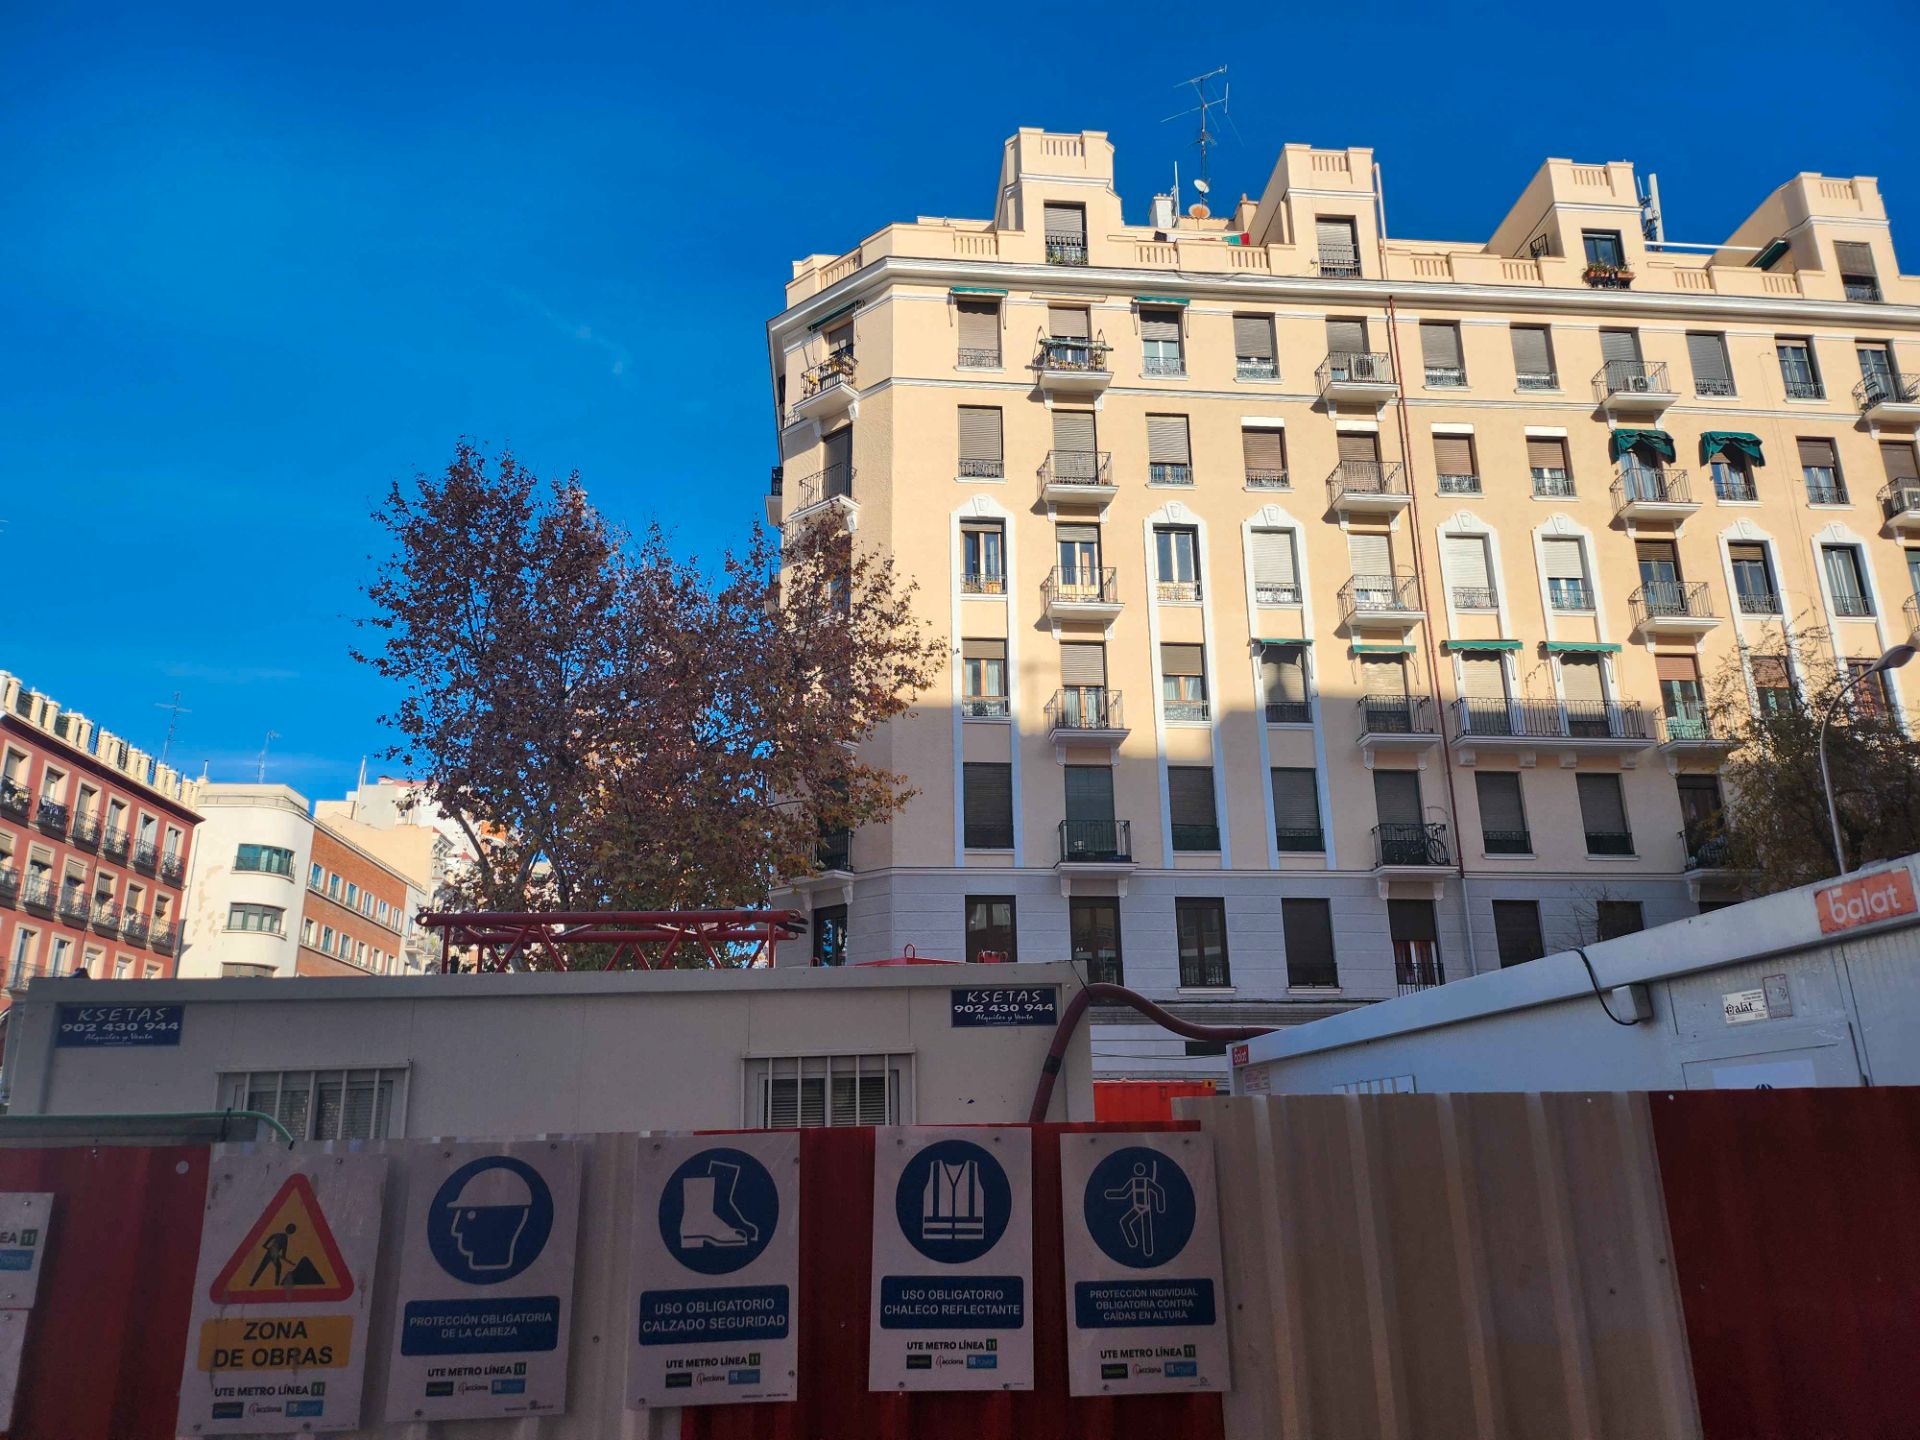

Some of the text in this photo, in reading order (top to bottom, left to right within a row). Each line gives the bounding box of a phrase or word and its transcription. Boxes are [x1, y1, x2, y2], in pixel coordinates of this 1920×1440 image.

[1828, 884, 1901, 924] balat
[967, 990, 1041, 1003] KSETAS
[954, 1003, 1054, 1013] 902 430 944
[78, 1008, 170, 1022] KSETAS
[61, 1022, 179, 1032] 902 430 944
[902, 1289, 1004, 1301] USO OBLIGATORIO
[1090, 1287, 1198, 1299] PROTECCIÓN INDIVIDUAL
[655, 1298, 775, 1315] USO OBLIGATORIO
[884, 1304, 1021, 1315] CHALECO REFLECTANTE
[1096, 1298, 1194, 1310] OBLIGATORIA CONTRA
[409, 1312, 552, 1327] PROTECCIÓN OBLIGATORIA
[1103, 1310, 1188, 1321] CAÍDAS EN ALTURA
[642, 1314, 786, 1332] CALZADO SEGURIDAD
[243, 1321, 308, 1341] ZONA
[441, 1326, 518, 1339] DE LA CABEZA
[906, 1339, 996, 1350] UTE METRO LÍNEA 11
[214, 1346, 333, 1368] DE OBRAS
[1100, 1350, 1118, 1359] UTE
[1120, 1348, 1153, 1358] METRO
[1155, 1346, 1182, 1357] LÍNEA
[666, 1359, 684, 1369] UTE
[685, 1358, 719, 1368] METRO
[720, 1355, 747, 1366] LÍNEA
[427, 1368, 446, 1377] UTE
[448, 1367, 482, 1377] METRO
[484, 1364, 512, 1375] LÍNEA
[214, 1387, 235, 1397] UTE
[237, 1386, 276, 1396] METRO
[278, 1383, 309, 1395] LÍNEA
